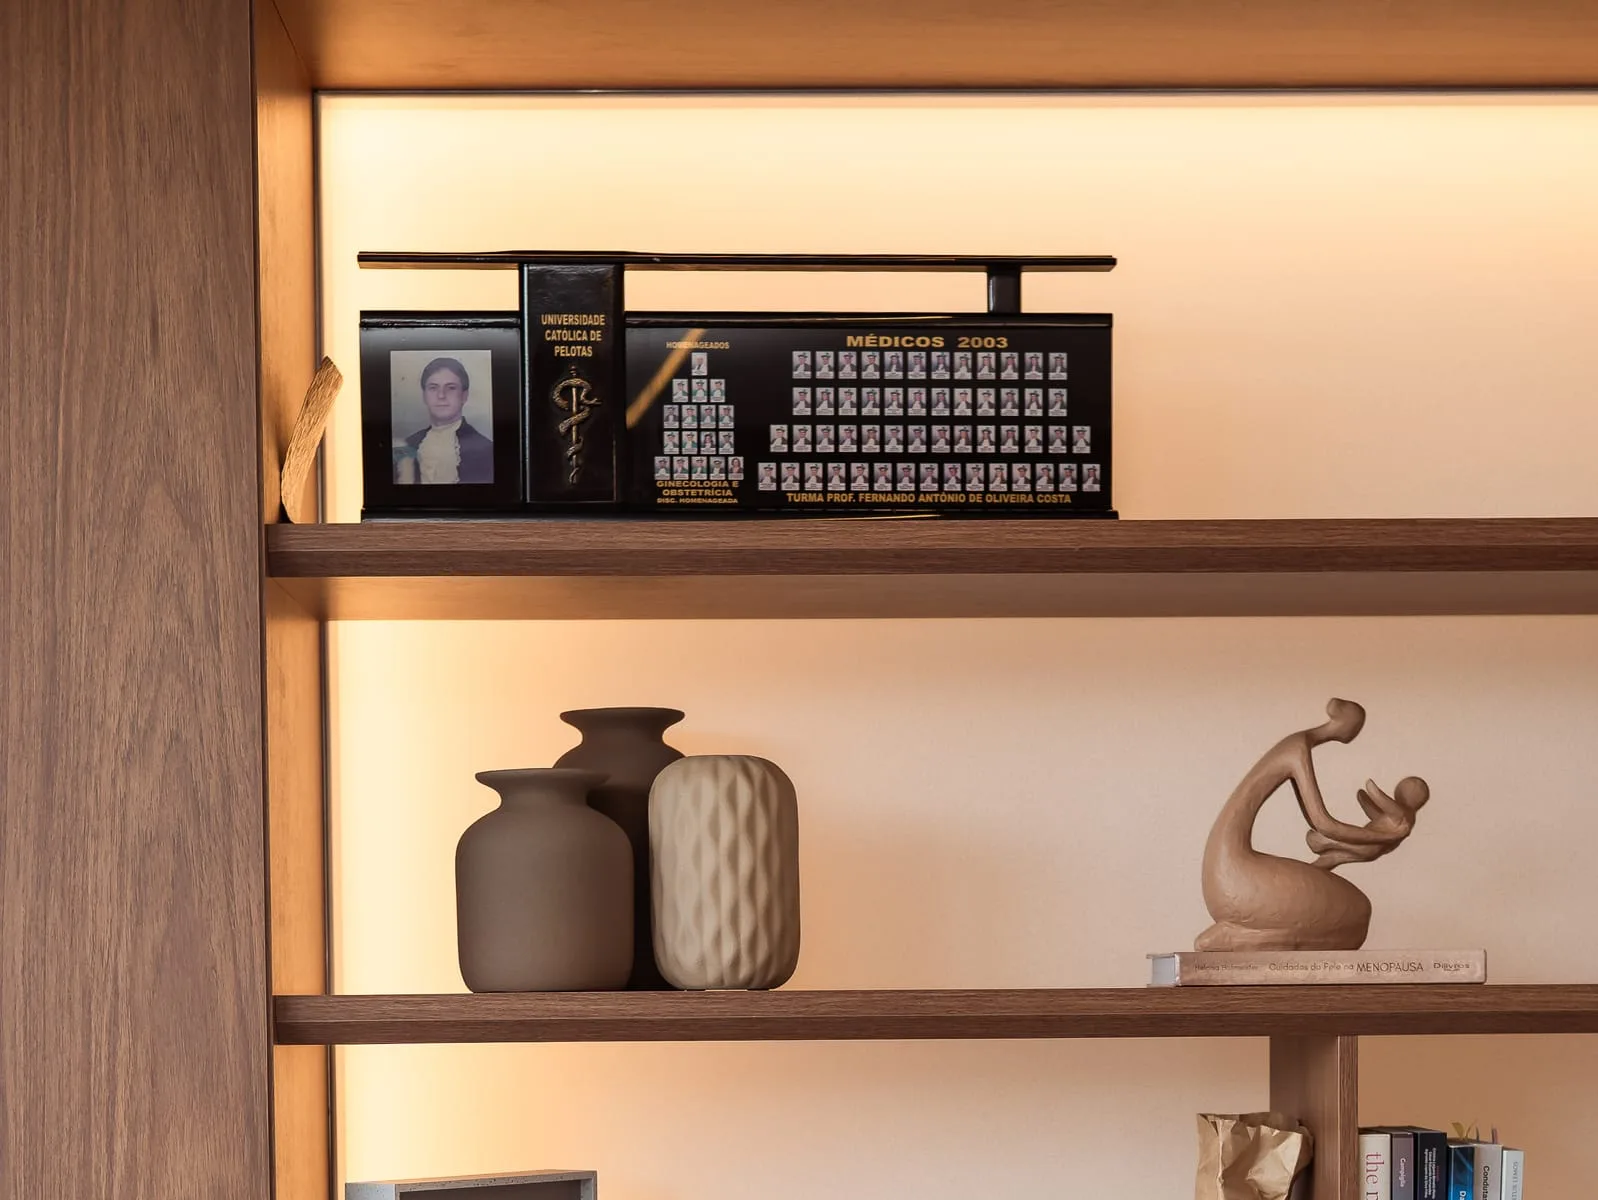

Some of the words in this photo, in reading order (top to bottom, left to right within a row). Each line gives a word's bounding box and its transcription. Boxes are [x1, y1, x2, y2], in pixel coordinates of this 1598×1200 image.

[541, 314, 605, 325] UNIVERSIDADE
[545, 328, 588, 341] CATÓLICA
[590, 330, 602, 341] DE
[846, 334, 945, 348] MÉDICOS
[958, 336, 1009, 349] 2003
[554, 345, 593, 357] PELOTAS
[656, 480, 730, 488] GINECOLOGIA
[732, 480, 740, 488] E
[662, 488, 733, 497] OBSTETRÍCIA
[786, 493, 824, 503] TURMA
[827, 493, 856, 503] PROF.
[859, 493, 915, 503] FERNANDO
[919, 492, 966, 503] ANTÔNIO
[969, 493, 981, 503] DE
[985, 493, 1034, 504] OLIVEIRA
[1036, 493, 1072, 504] COSTA
[1268, 962, 1309, 971] Cuidados
[1356, 962, 1424, 972] MENOPAUSA
[1366, 1152, 1384, 1184] the
[1459, 1190, 1467, 1200] Da
